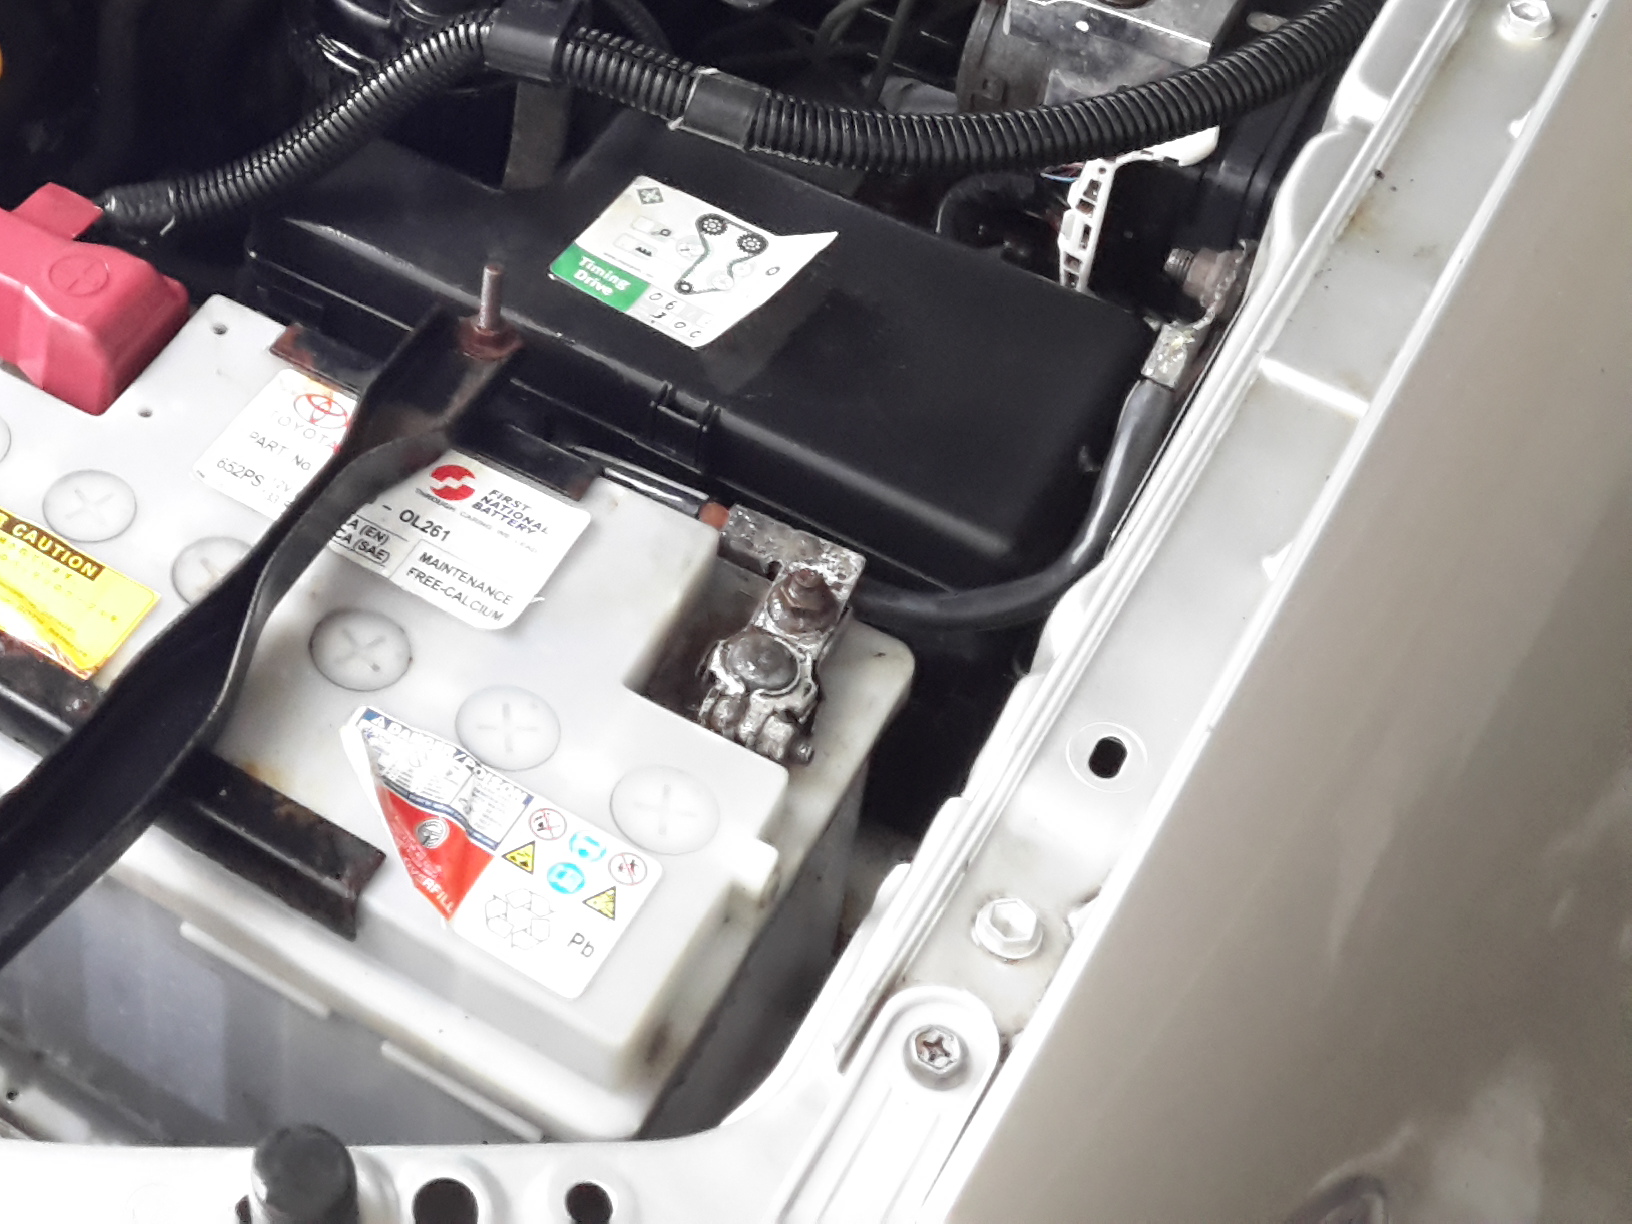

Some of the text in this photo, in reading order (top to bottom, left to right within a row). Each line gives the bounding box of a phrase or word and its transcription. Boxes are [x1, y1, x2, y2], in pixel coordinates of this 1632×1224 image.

[573, 269, 614, 297] Drive
[579, 255, 631, 291] Timing
[249, 431, 289, 455] PART
[216, 457, 265, 487] 652PS
[480, 495, 550, 534] NATIONAL
[488, 489, 531, 511] FIRST
[399, 509, 451, 542] OL261
[471, 501, 537, 534] BATTERY
[359, 522, 390, 546] (EN)
[11, 523, 98, 578] CAUTION
[353, 536, 391, 564] (SAE)
[406, 566, 504, 622] FREE-CALCIUM
[419, 551, 514, 606] MAINTENANCE
[567, 932, 595, 958] Pb
